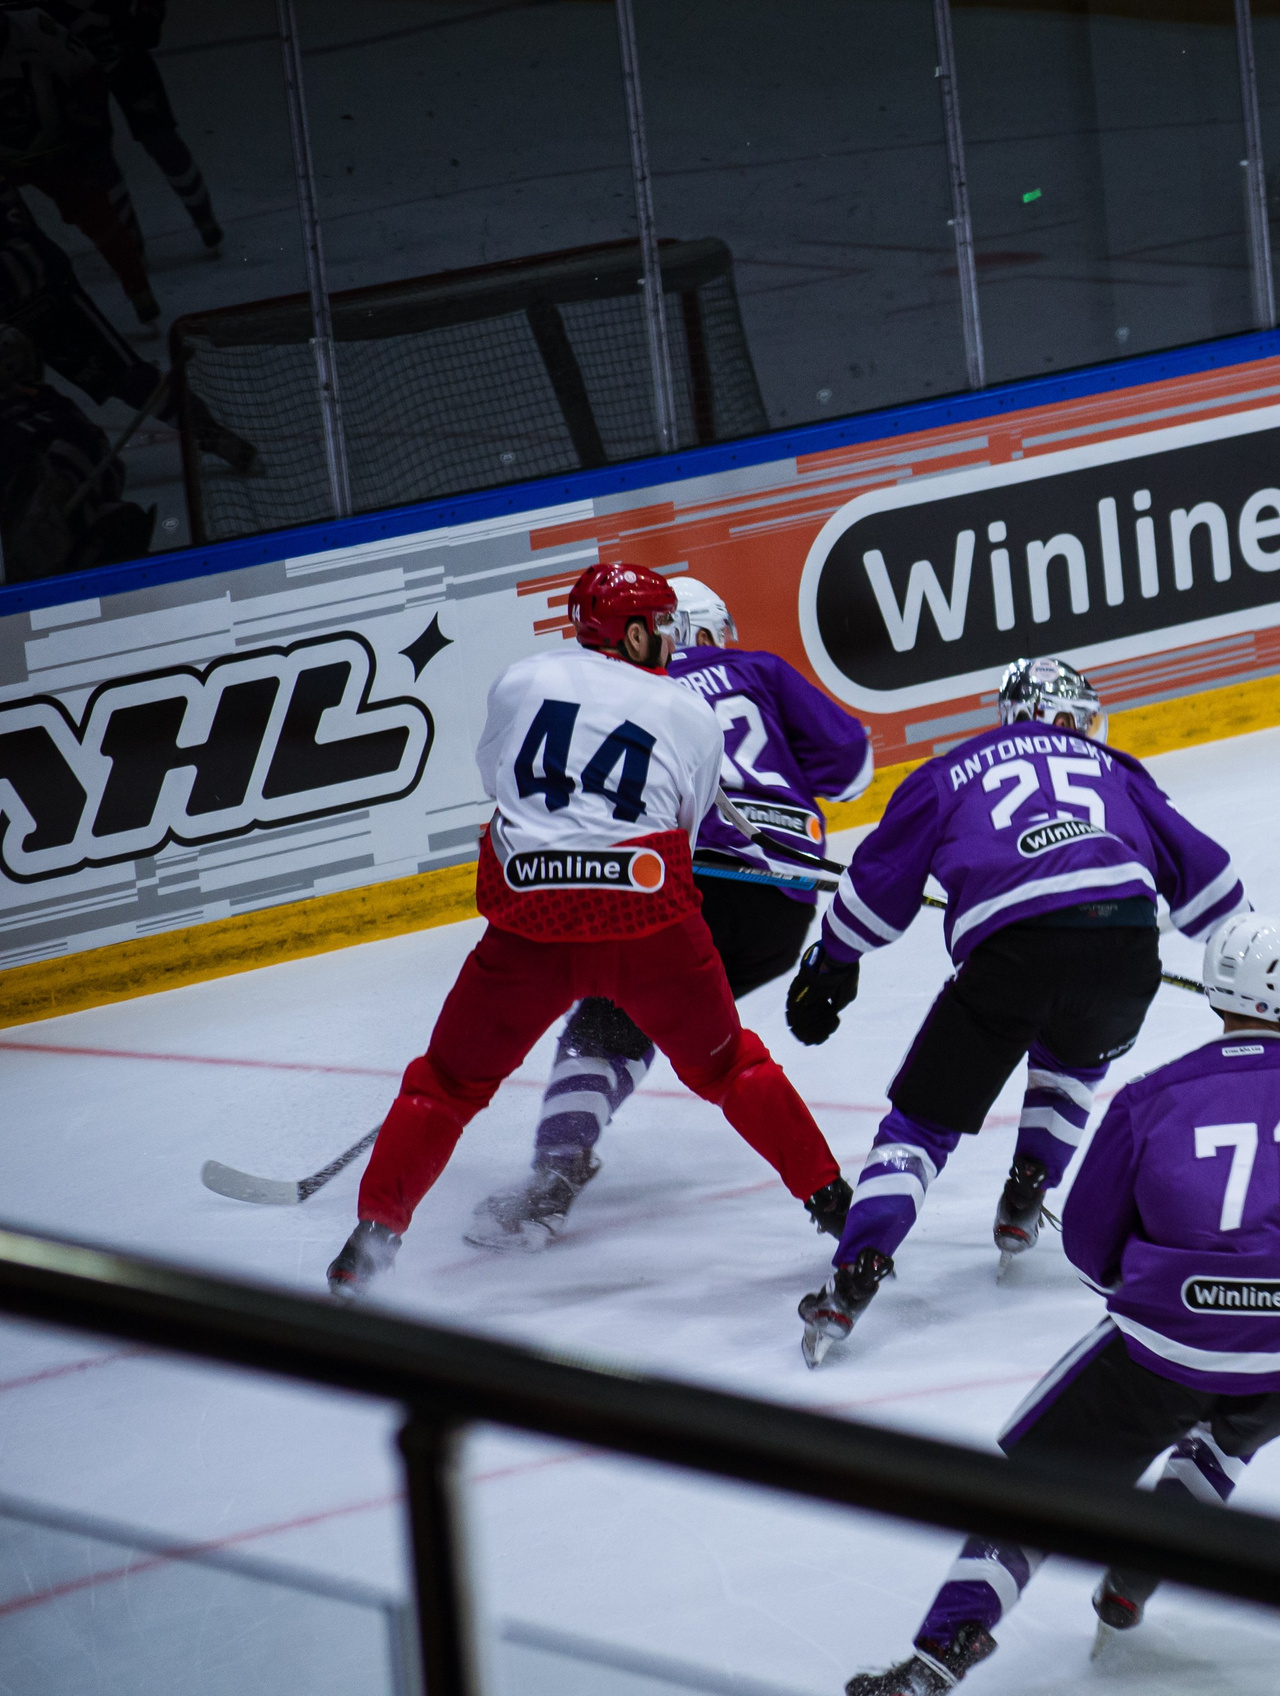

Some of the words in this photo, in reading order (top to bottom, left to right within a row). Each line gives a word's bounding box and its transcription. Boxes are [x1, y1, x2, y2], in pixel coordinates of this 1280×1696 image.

[513, 698, 658, 823] 44
[981, 755, 1106, 832] 25
[1026, 821, 1103, 850] Winlin
[515, 855, 621, 882] Winline
